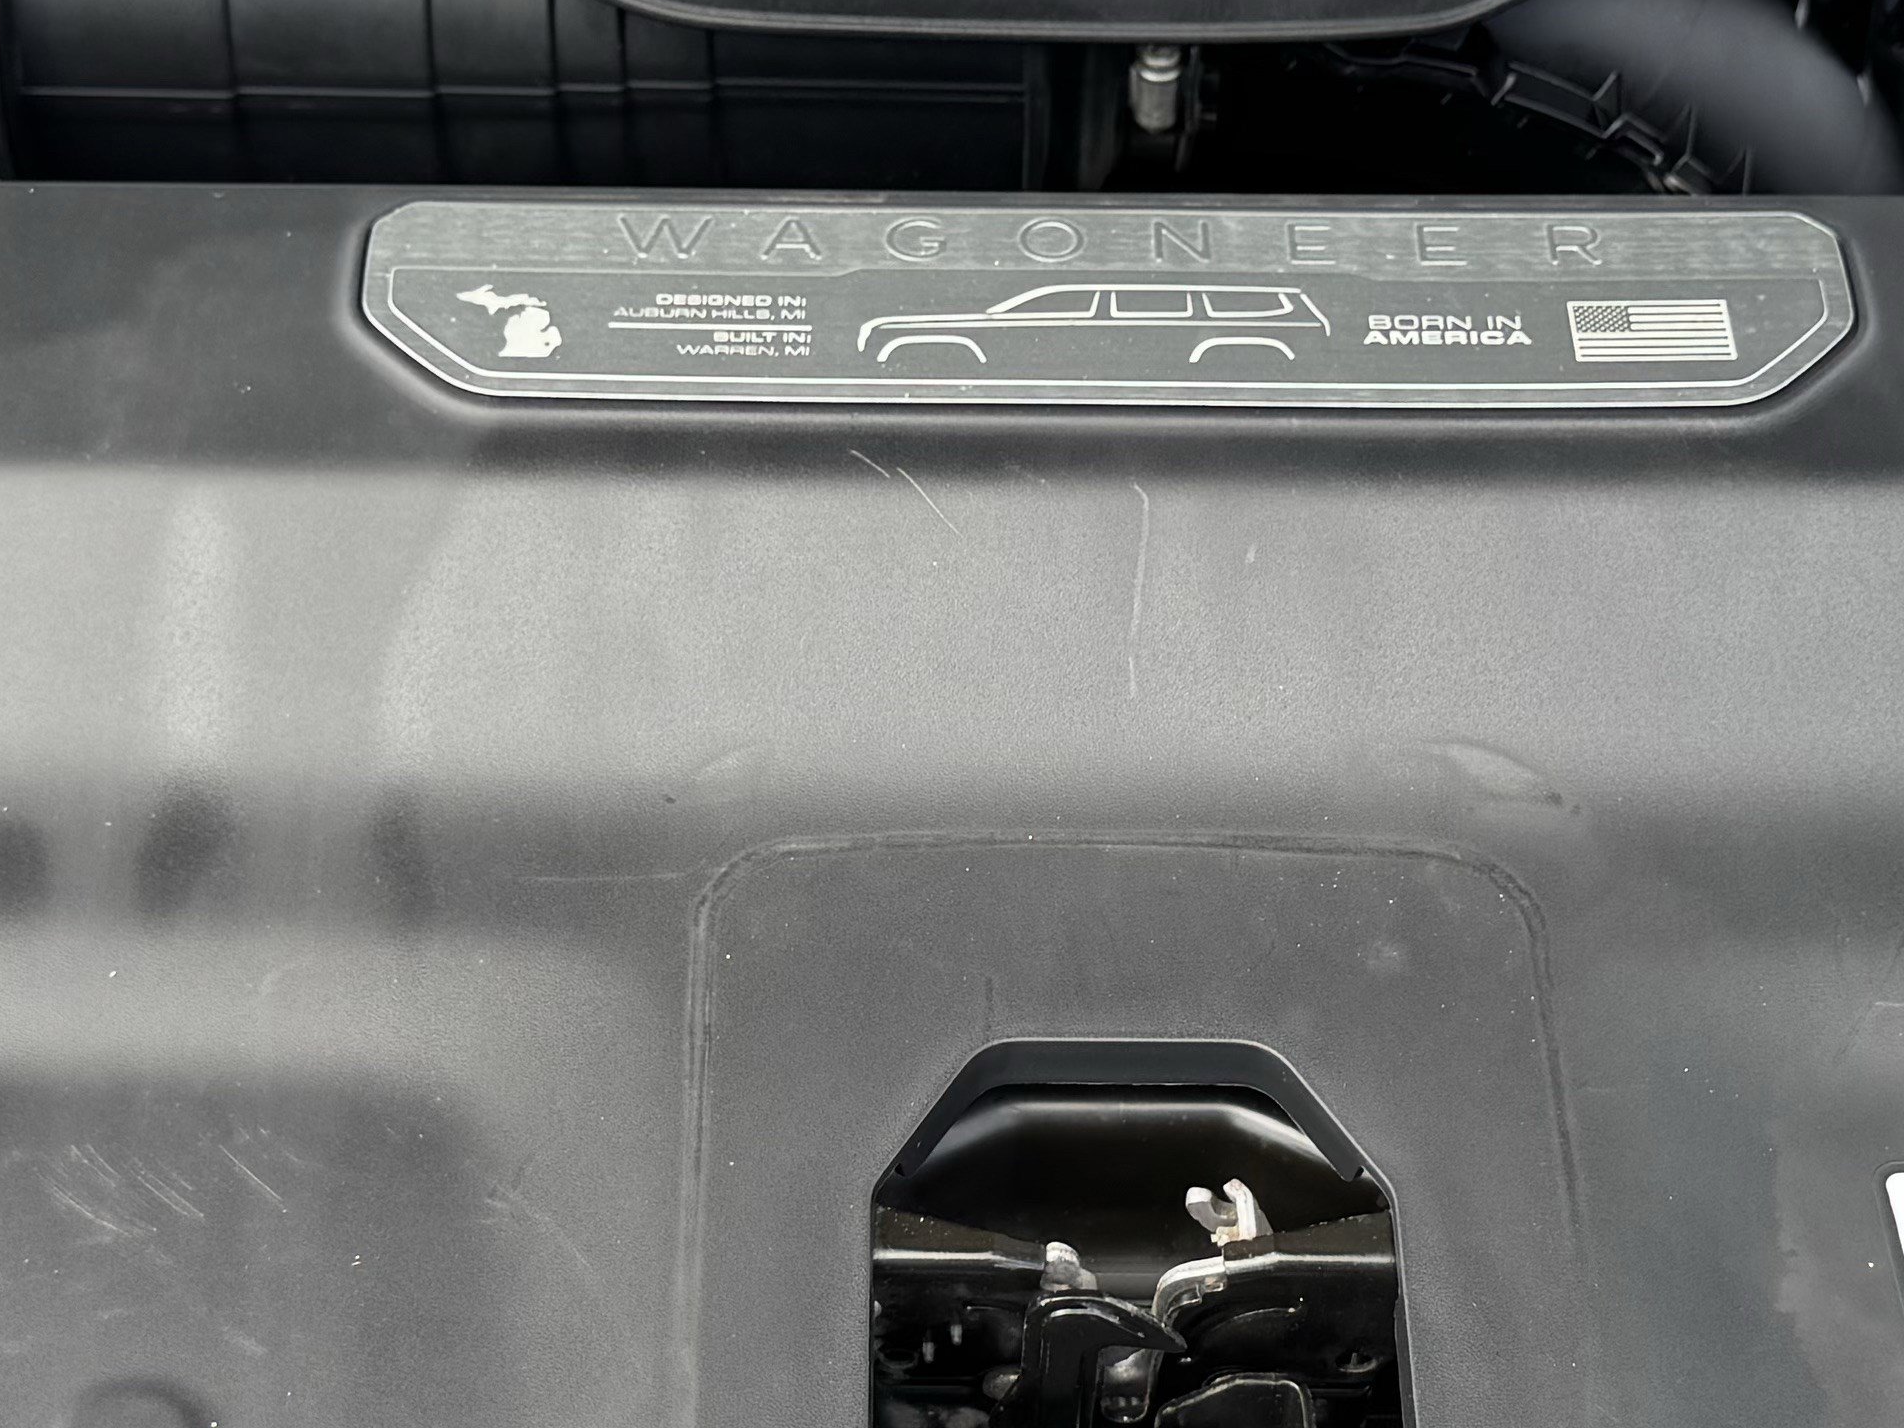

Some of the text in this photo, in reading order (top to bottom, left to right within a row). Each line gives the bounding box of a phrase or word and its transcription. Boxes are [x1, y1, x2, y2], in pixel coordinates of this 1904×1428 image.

[617, 213, 1604, 266] WAGONEER
[656, 293, 772, 307] DESIGNED
[613, 306, 806, 321] AUBURN HILLS, MI
[1368, 314, 1522, 330] BORN IN
[713, 331, 777, 343] BUILT
[1363, 330, 1533, 345] AMERICA
[676, 344, 810, 357] WARREN, MI
